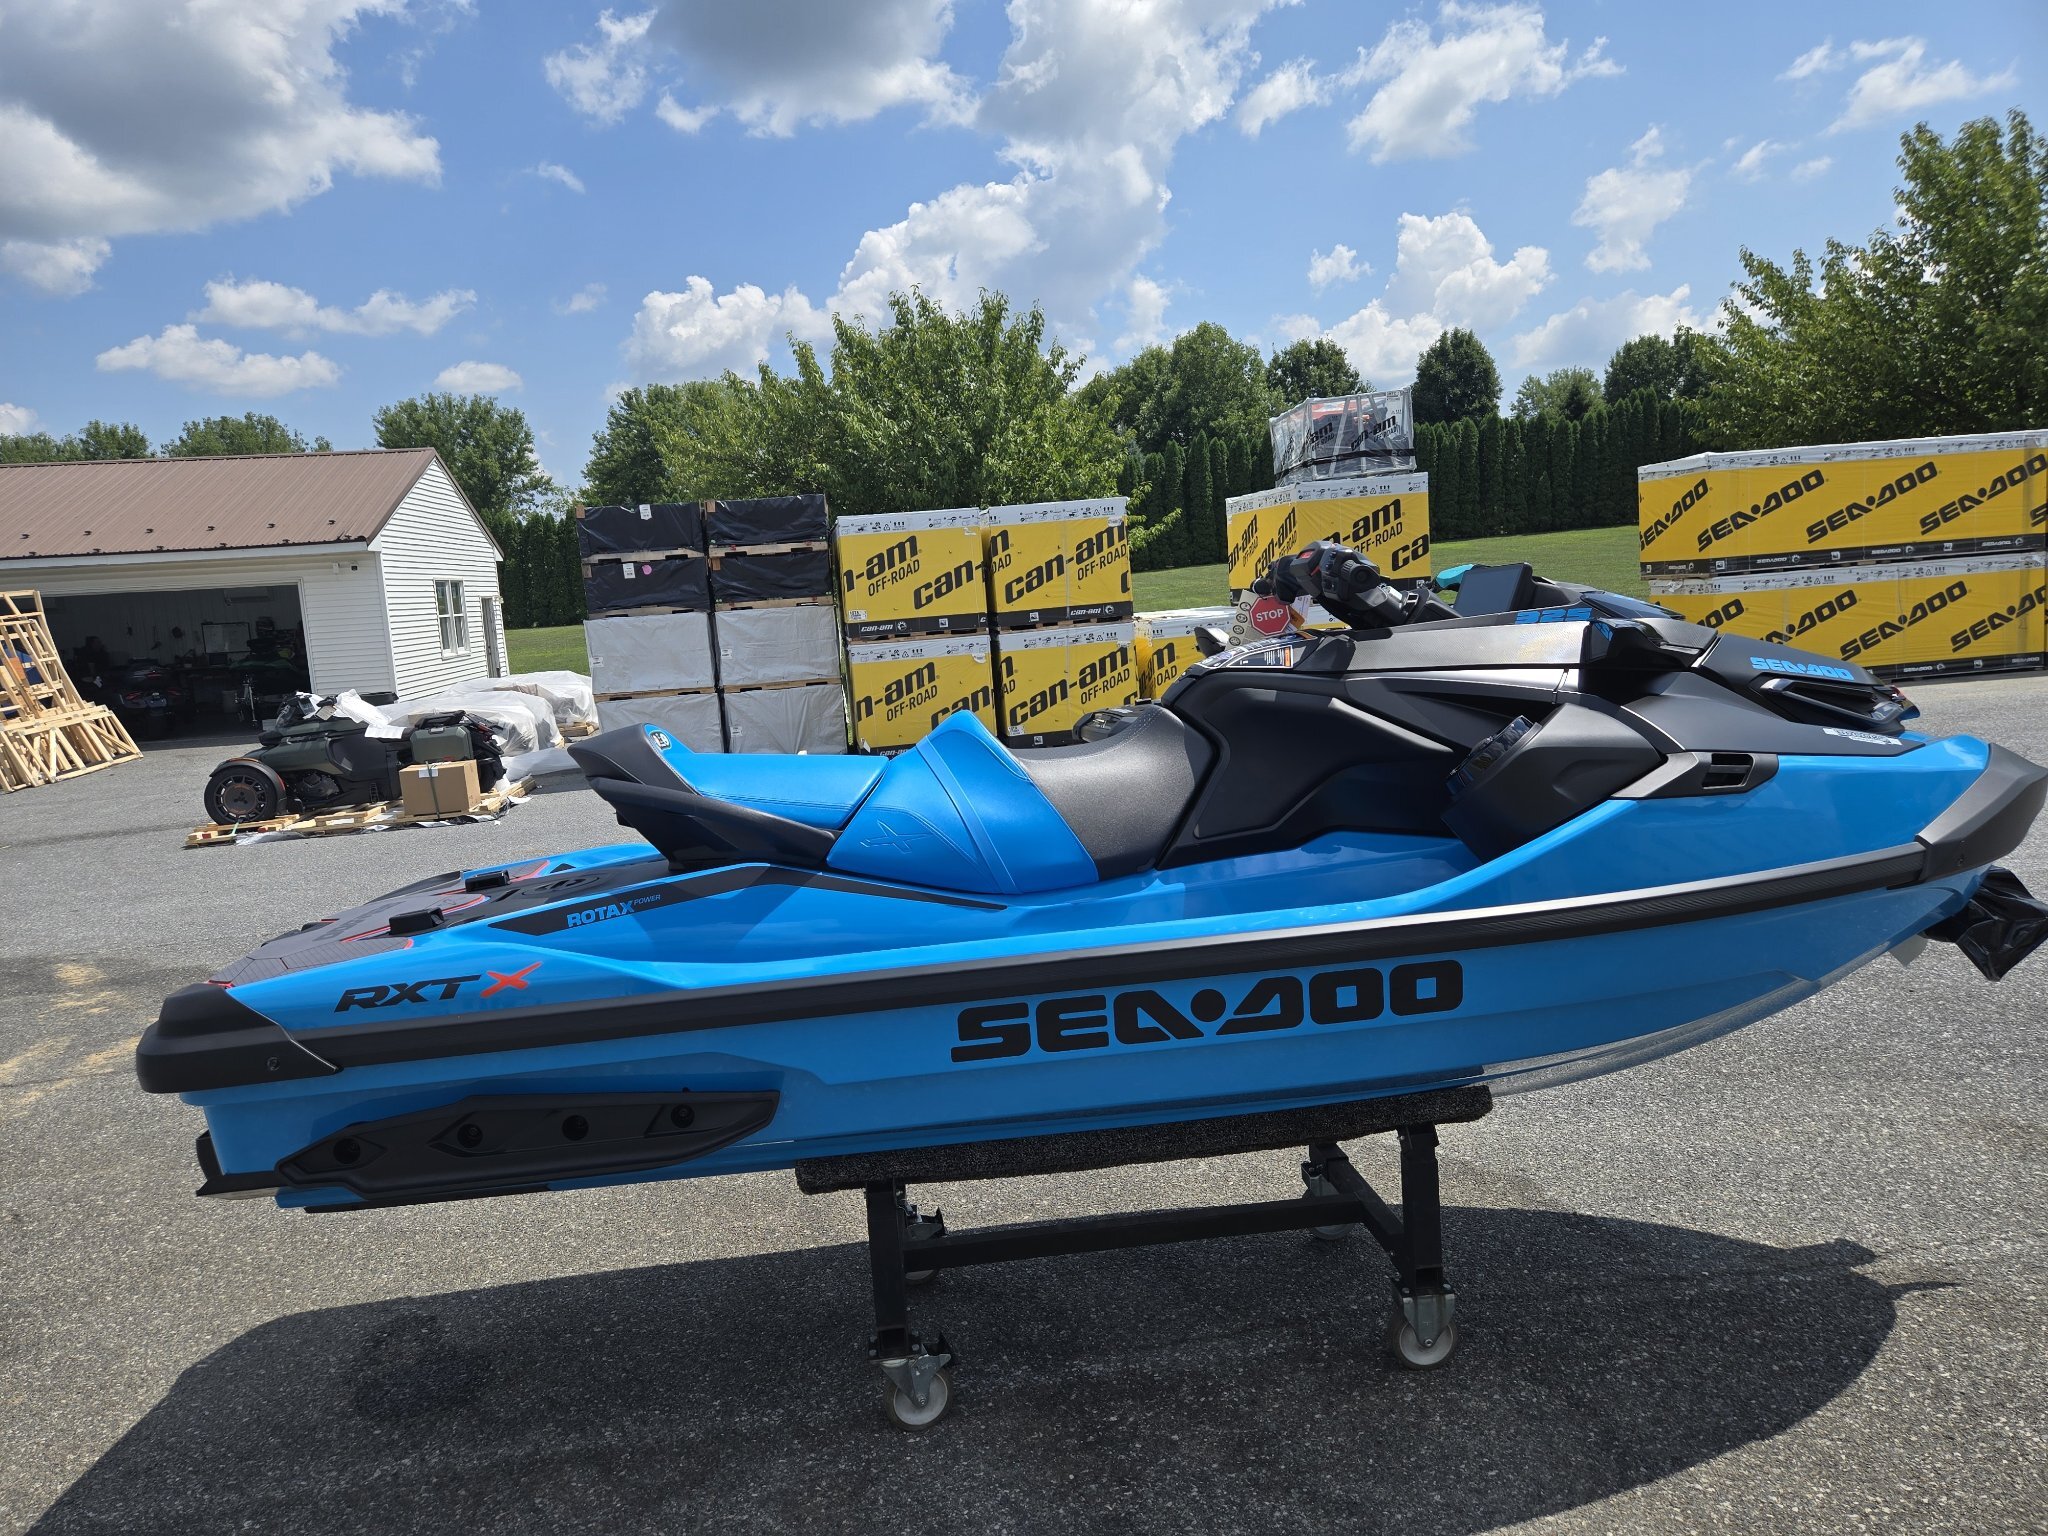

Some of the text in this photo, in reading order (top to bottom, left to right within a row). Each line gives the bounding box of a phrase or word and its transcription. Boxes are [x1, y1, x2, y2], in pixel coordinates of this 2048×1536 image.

[868, 559, 920, 597] OFF-ROAD
[1004, 521, 1126, 605] can-am
[1077, 543, 1127, 581] OFF-ROAD
[861, 624, 894, 632] can-am
[1256, 608, 1284, 622] STOP
[887, 685, 938, 722] OFF-ROAD
[1009, 646, 1129, 727] can-am
[1080, 668, 1130, 705] OFF-ROAD
[566, 894, 661, 928] ROTAX POWER
[334, 961, 543, 1013] RXT X
